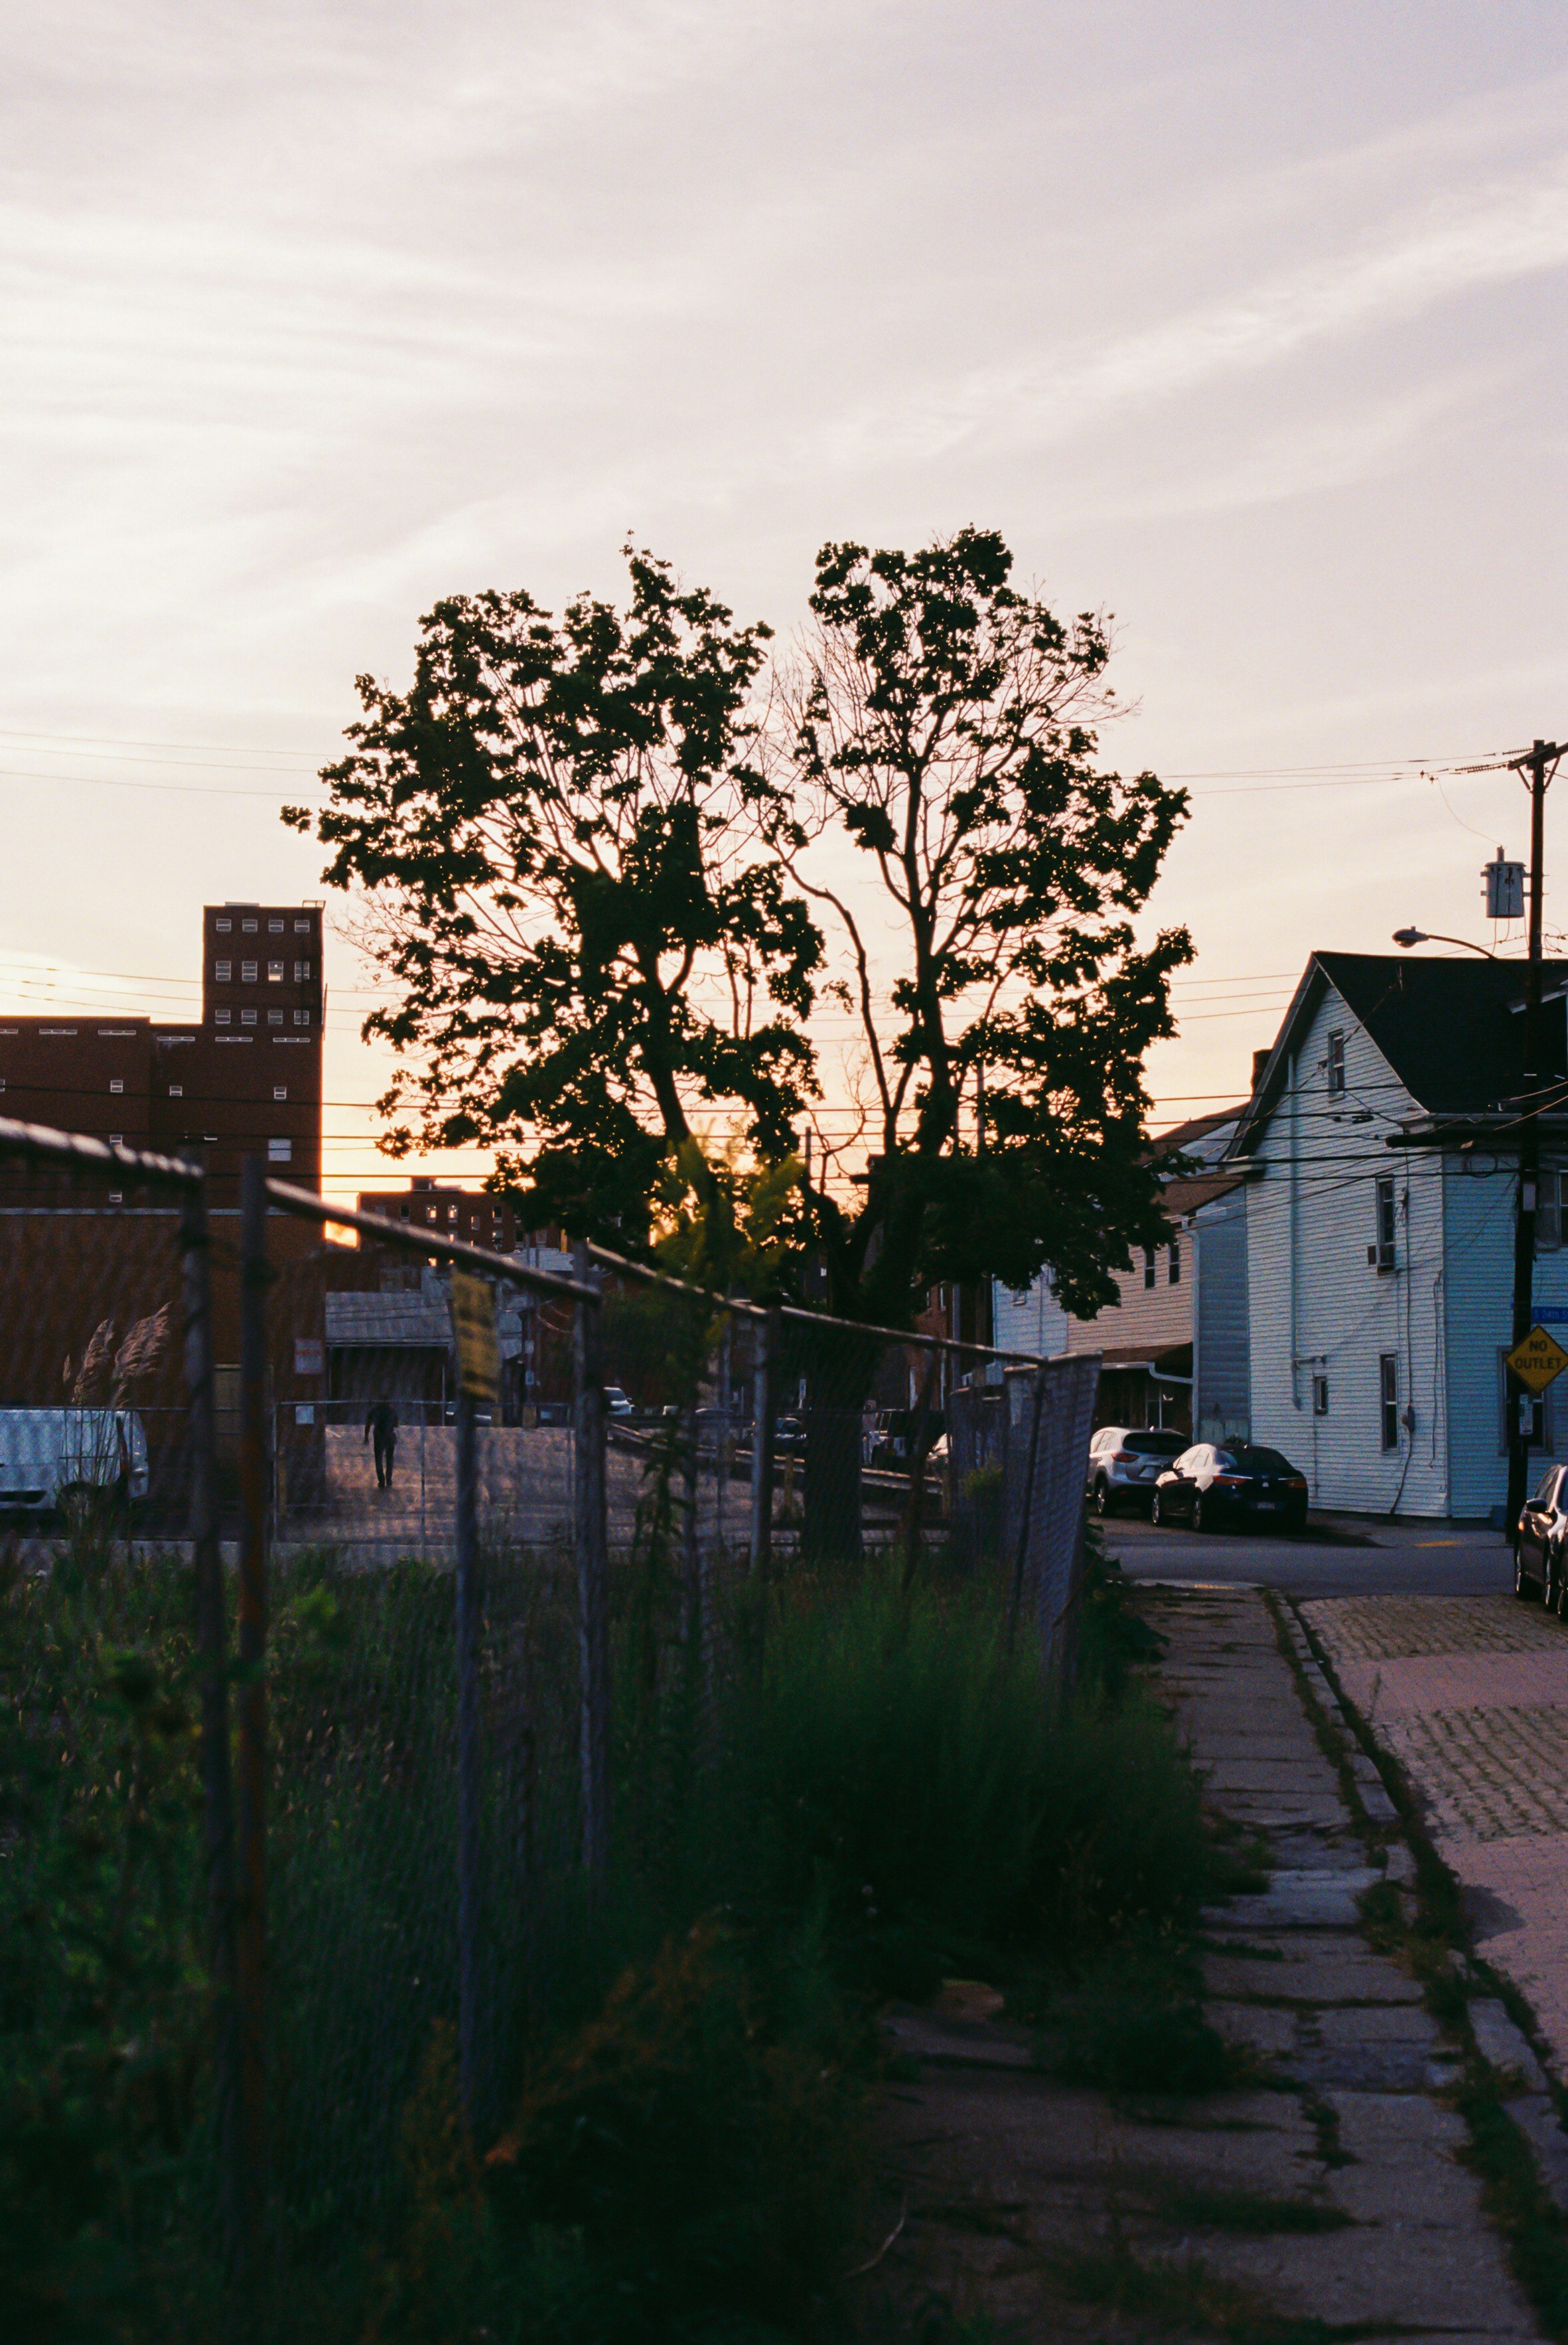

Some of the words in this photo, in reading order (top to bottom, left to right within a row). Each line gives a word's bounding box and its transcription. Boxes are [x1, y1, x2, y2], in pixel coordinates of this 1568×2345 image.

[1534, 1310, 1539, 1320] S
[1541, 1310, 1560, 1320] 24th
[1562, 1310, 1568, 1320] S
[1530, 1339, 1547, 1352] NO
[1515, 1357, 1563, 1369] OUTLET
